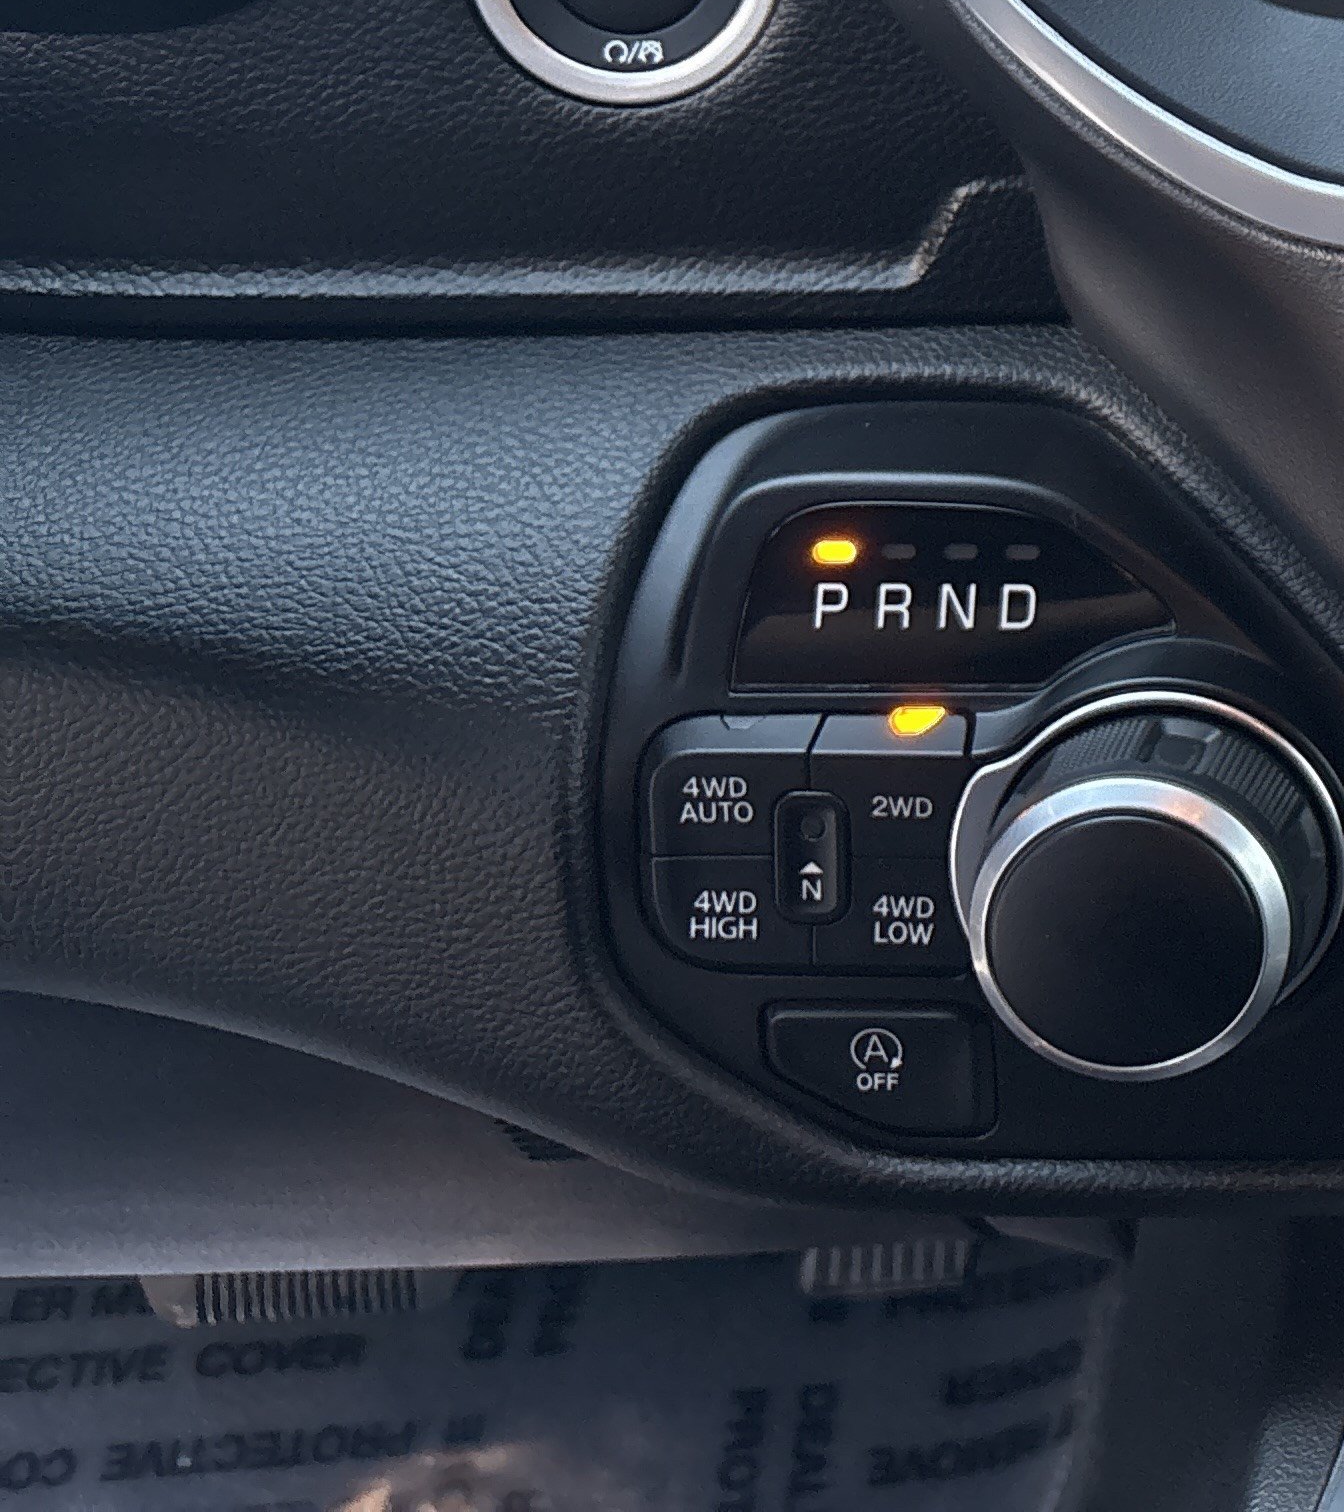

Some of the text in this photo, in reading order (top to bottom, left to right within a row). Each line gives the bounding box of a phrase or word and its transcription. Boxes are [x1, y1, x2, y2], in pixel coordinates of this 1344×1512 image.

[814, 582, 1037, 630] P R N D
[682, 776, 748, 798] 4WD
[679, 801, 754, 824] AUTO
[871, 795, 933, 819] 2WD
[693, 890, 757, 914] 4WD
[801, 879, 822, 901] N
[872, 895, 935, 919] 4WD
[689, 916, 758, 940] HIGH
[873, 921, 934, 946] LOW
[856, 1073, 899, 1091] OFF
